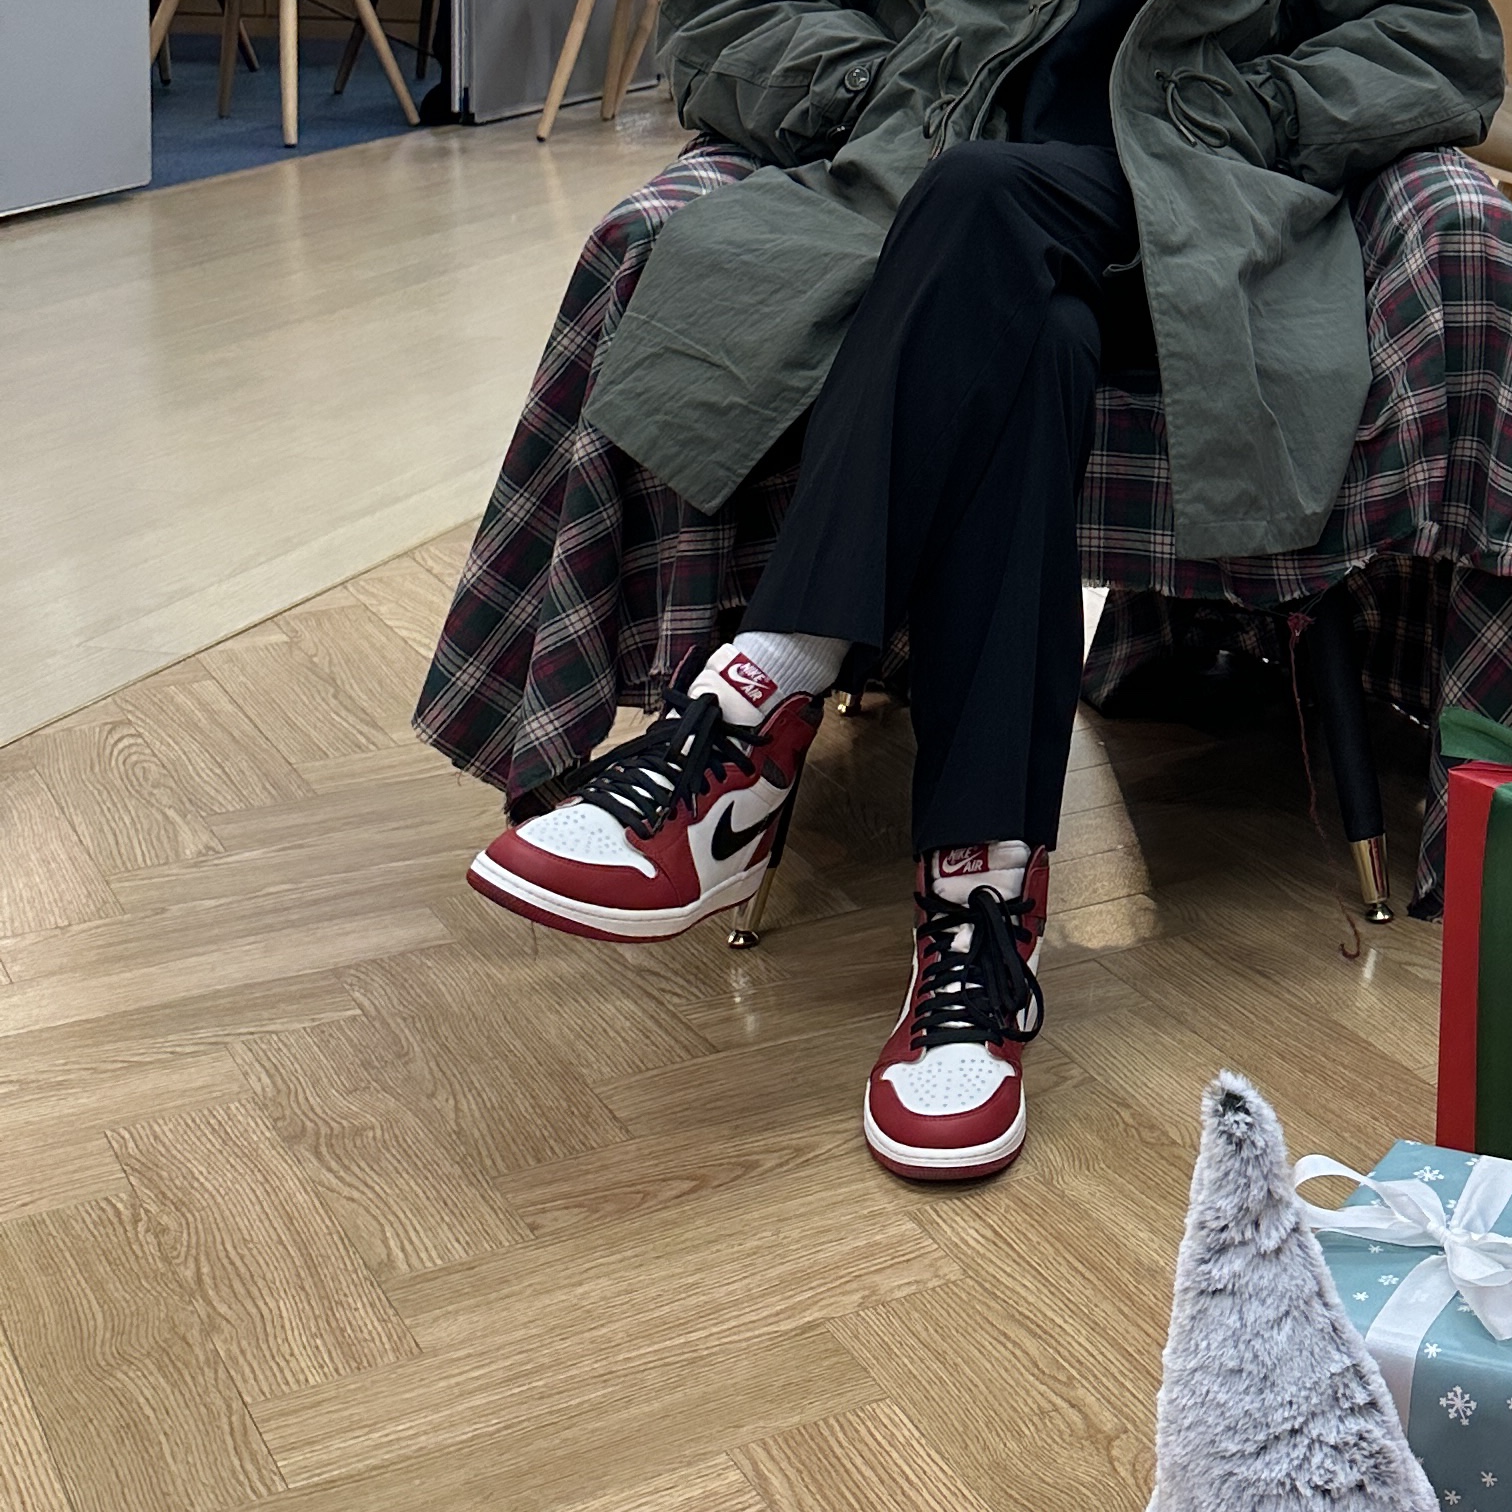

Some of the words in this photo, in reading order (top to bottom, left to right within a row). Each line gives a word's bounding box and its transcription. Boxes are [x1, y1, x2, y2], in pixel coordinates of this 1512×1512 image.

[739, 662, 767, 683] NIKE
[740, 685, 763, 702] AIR
[963, 859, 983, 873] AIR
